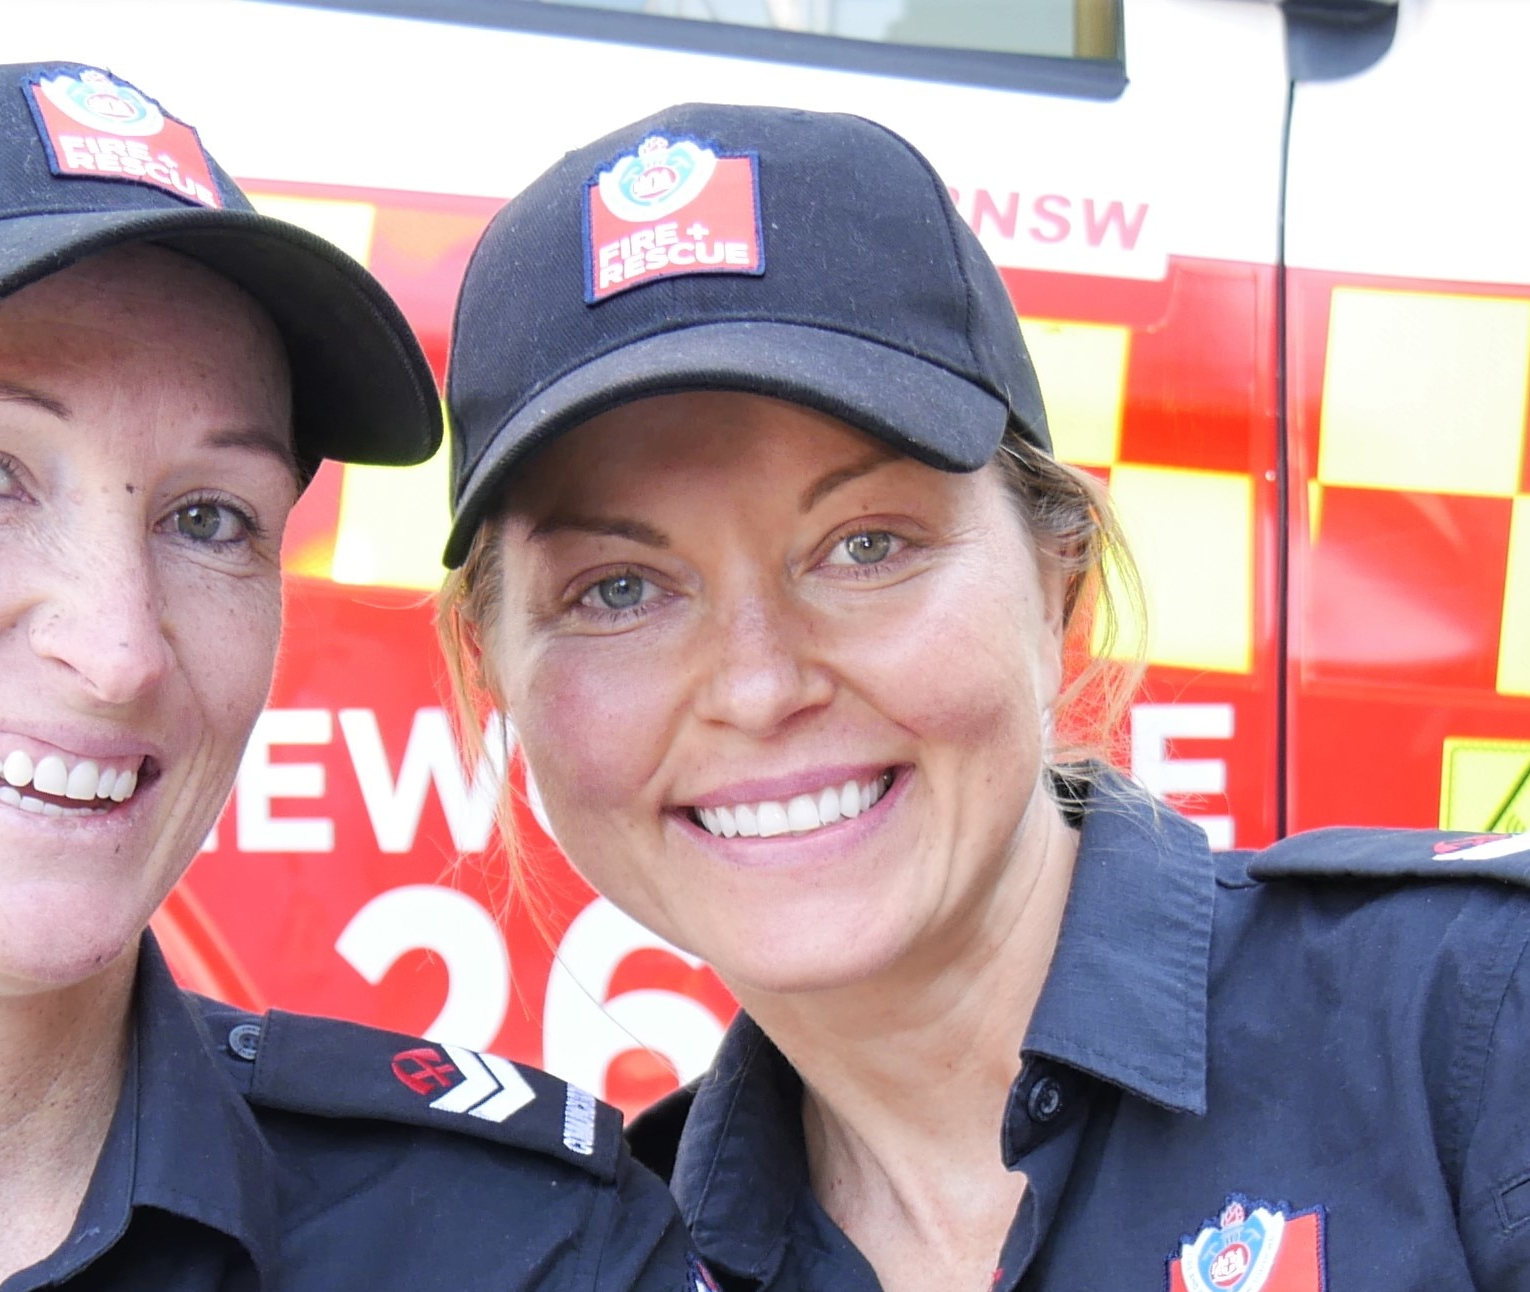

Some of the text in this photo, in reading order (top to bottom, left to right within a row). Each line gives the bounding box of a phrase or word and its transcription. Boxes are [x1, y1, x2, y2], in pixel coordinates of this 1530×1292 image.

[59, 135, 152, 162] FIRE
[67, 151, 220, 208] RESCUE
[598, 221, 679, 269] FIRE
[598, 242, 751, 290] RESCUE
[335, 884, 726, 1100] 26
